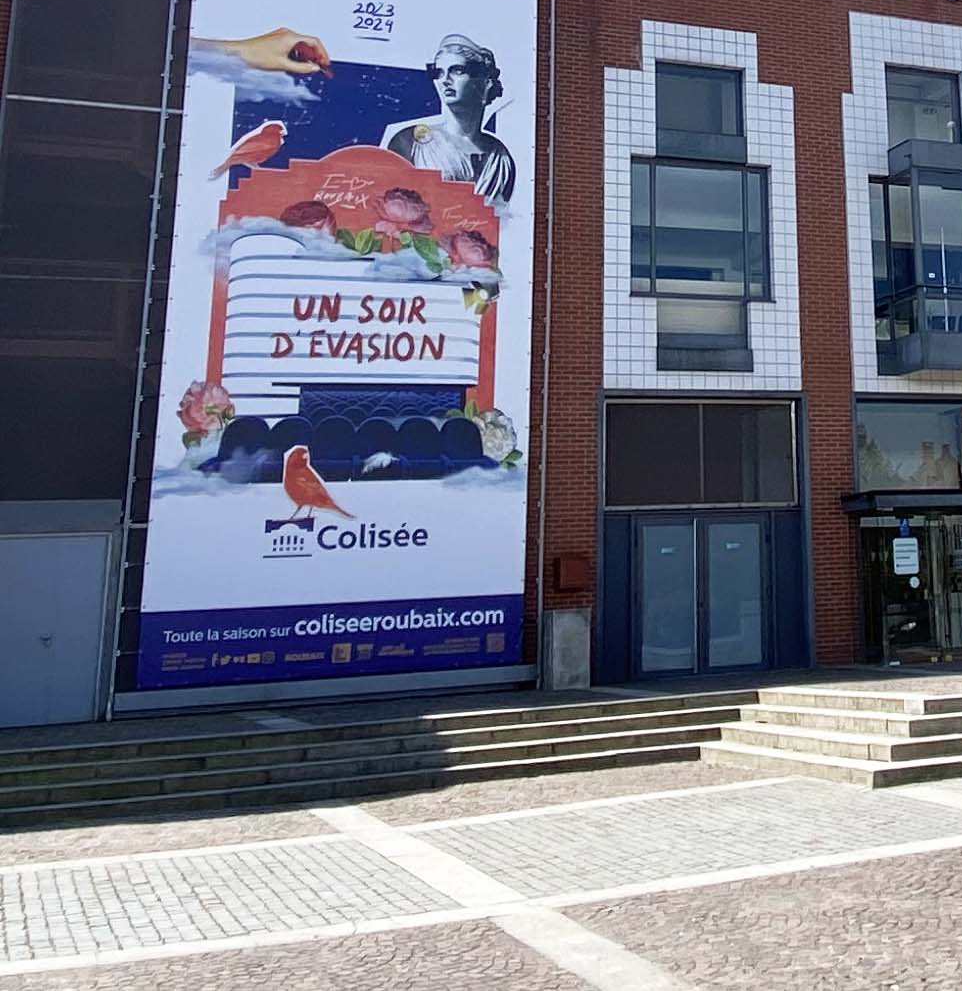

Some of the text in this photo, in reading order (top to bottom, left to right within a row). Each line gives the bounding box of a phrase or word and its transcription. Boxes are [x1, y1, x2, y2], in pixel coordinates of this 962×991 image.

[352, 1, 395, 17] 2023
[353, 16, 394, 34] 2024
[293, 292, 426, 325] UN SOIR
[316, 522, 429, 551] Colisée
[163, 608, 504, 644] Toute la saison sur coliseeroubaix.com
